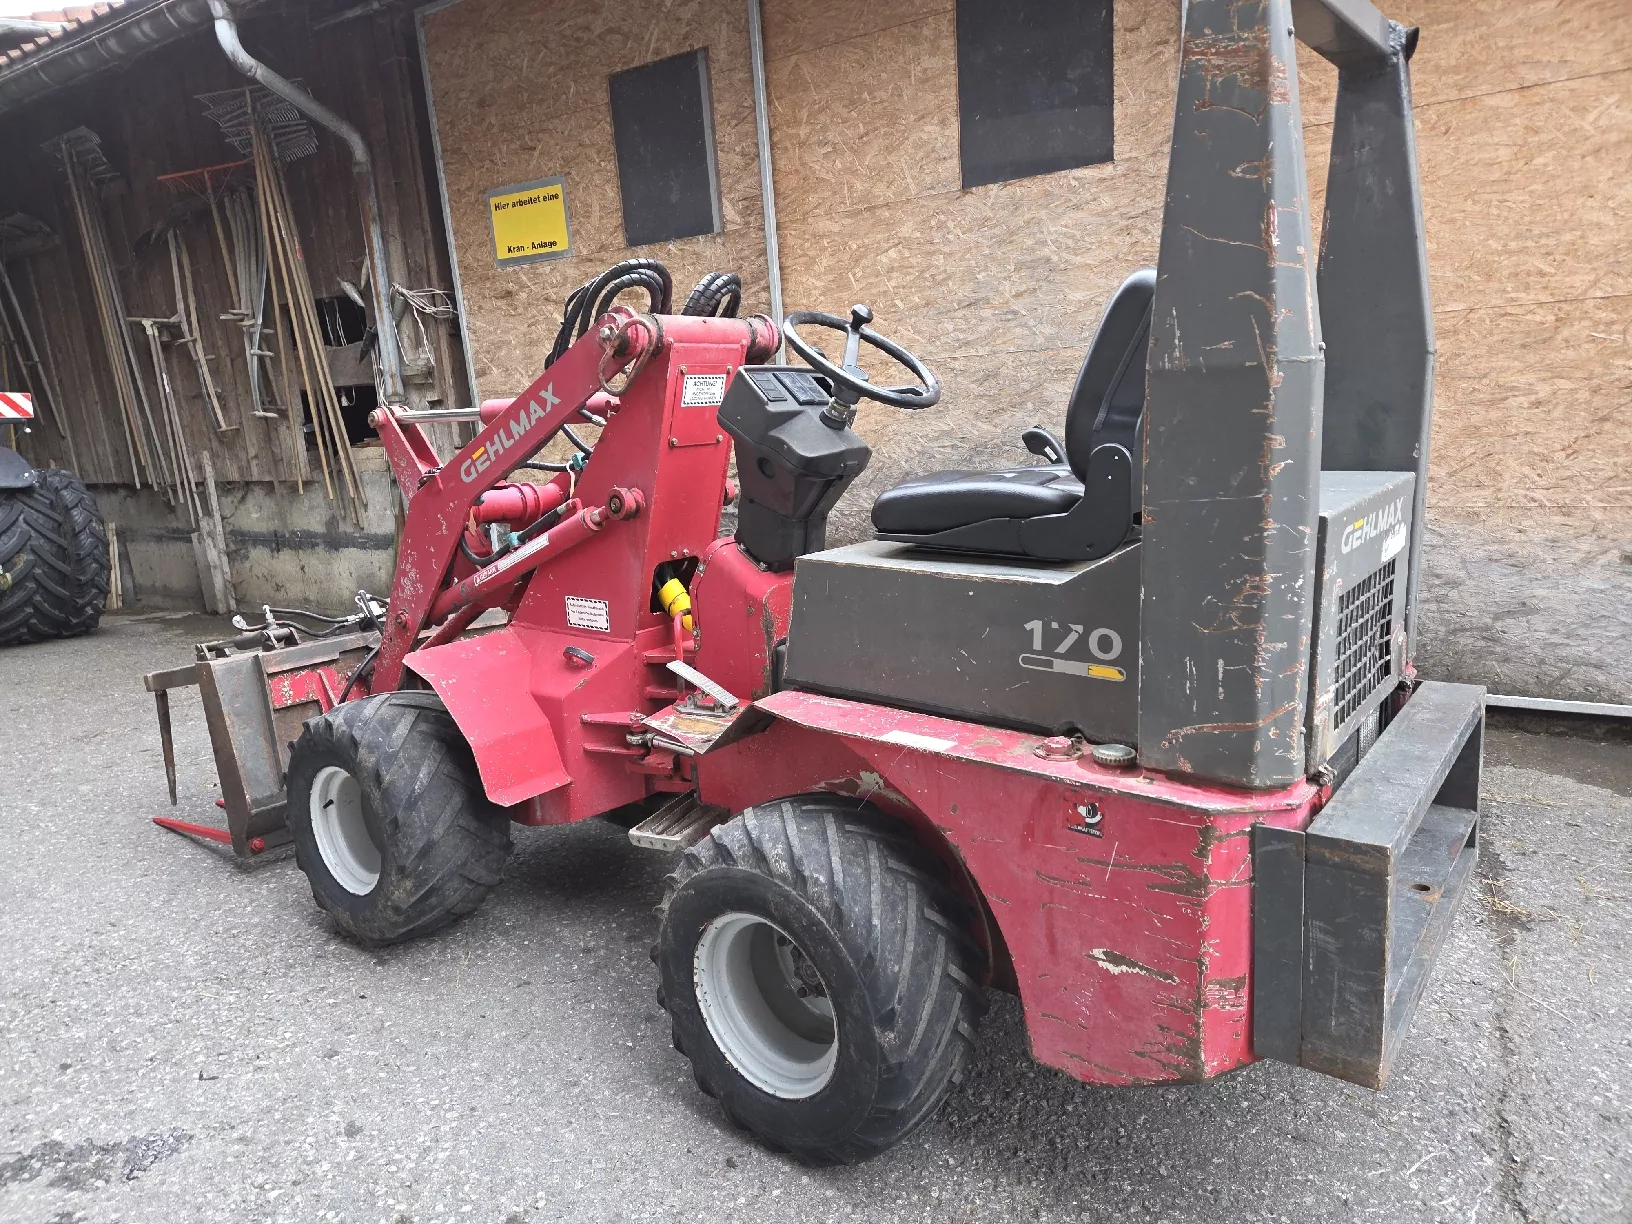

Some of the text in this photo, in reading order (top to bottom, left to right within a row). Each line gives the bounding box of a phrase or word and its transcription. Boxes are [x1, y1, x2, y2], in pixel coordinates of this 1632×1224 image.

[494, 193, 559, 211] Hier arbeitet eine
[507, 245, 525, 254] Kran
[531, 240, 557, 250] Anlage
[460, 381, 562, 483] GEHLMAX
[1341, 496, 1404, 555] GEHLMAX
[1023, 619, 1123, 661] 170
